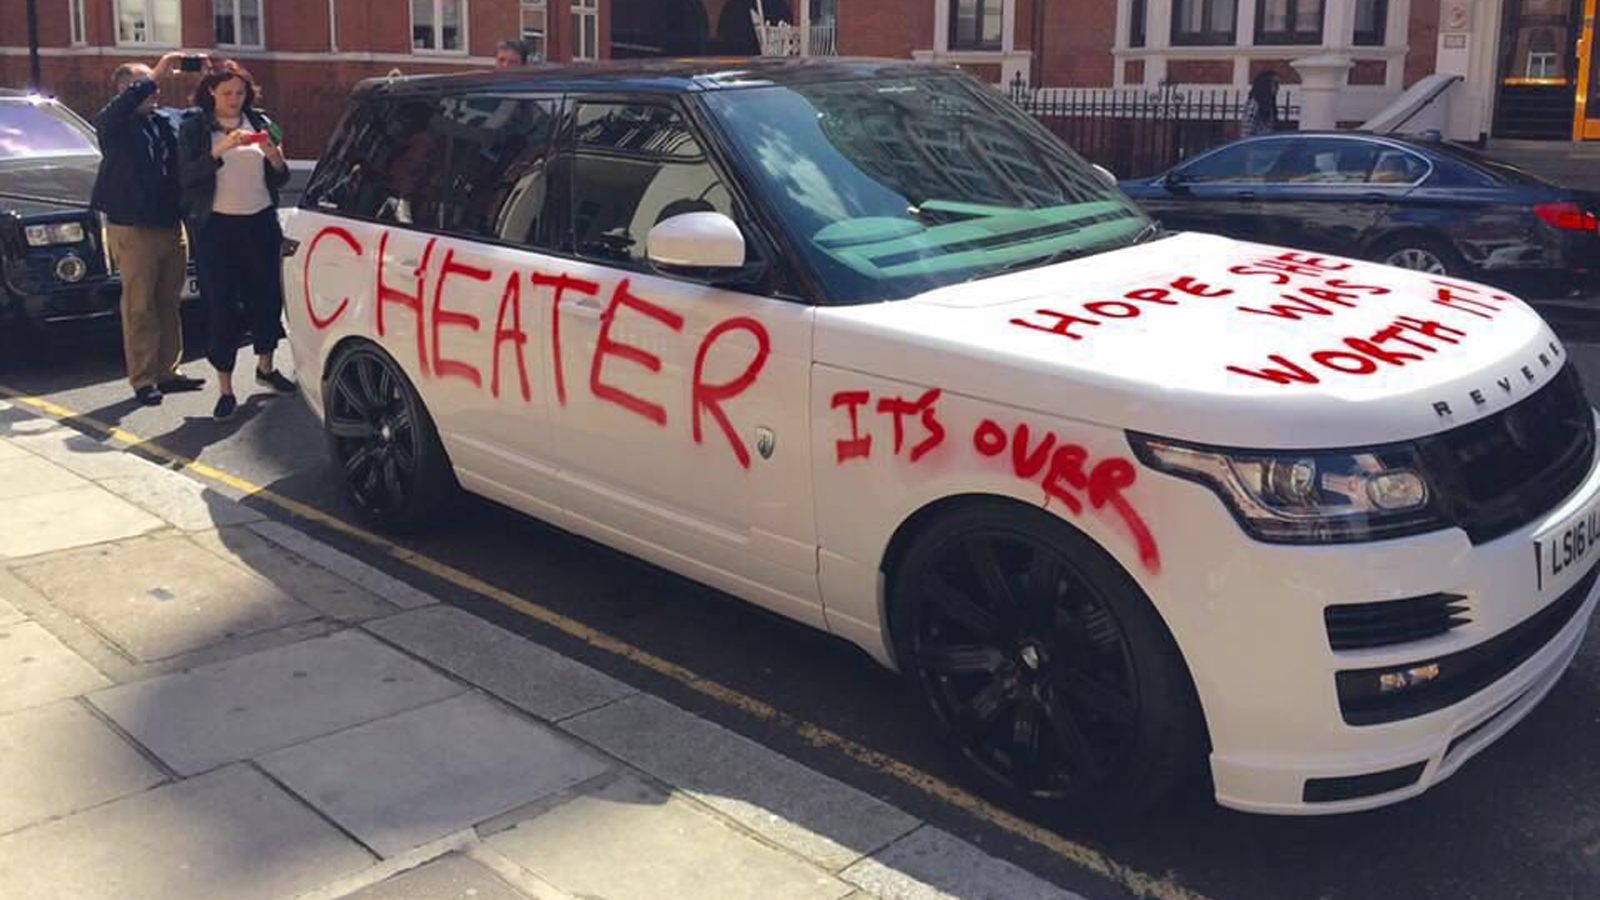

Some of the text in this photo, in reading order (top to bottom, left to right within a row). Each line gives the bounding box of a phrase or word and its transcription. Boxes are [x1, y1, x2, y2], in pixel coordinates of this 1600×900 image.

[1010, 251, 1353, 342] HOPE SHE
[1237, 278, 1392, 321] WAS
[304, 226, 774, 470] CHEATER
[1225, 314, 1467, 387] WORTH
[972, 418, 1163, 575] OVER
